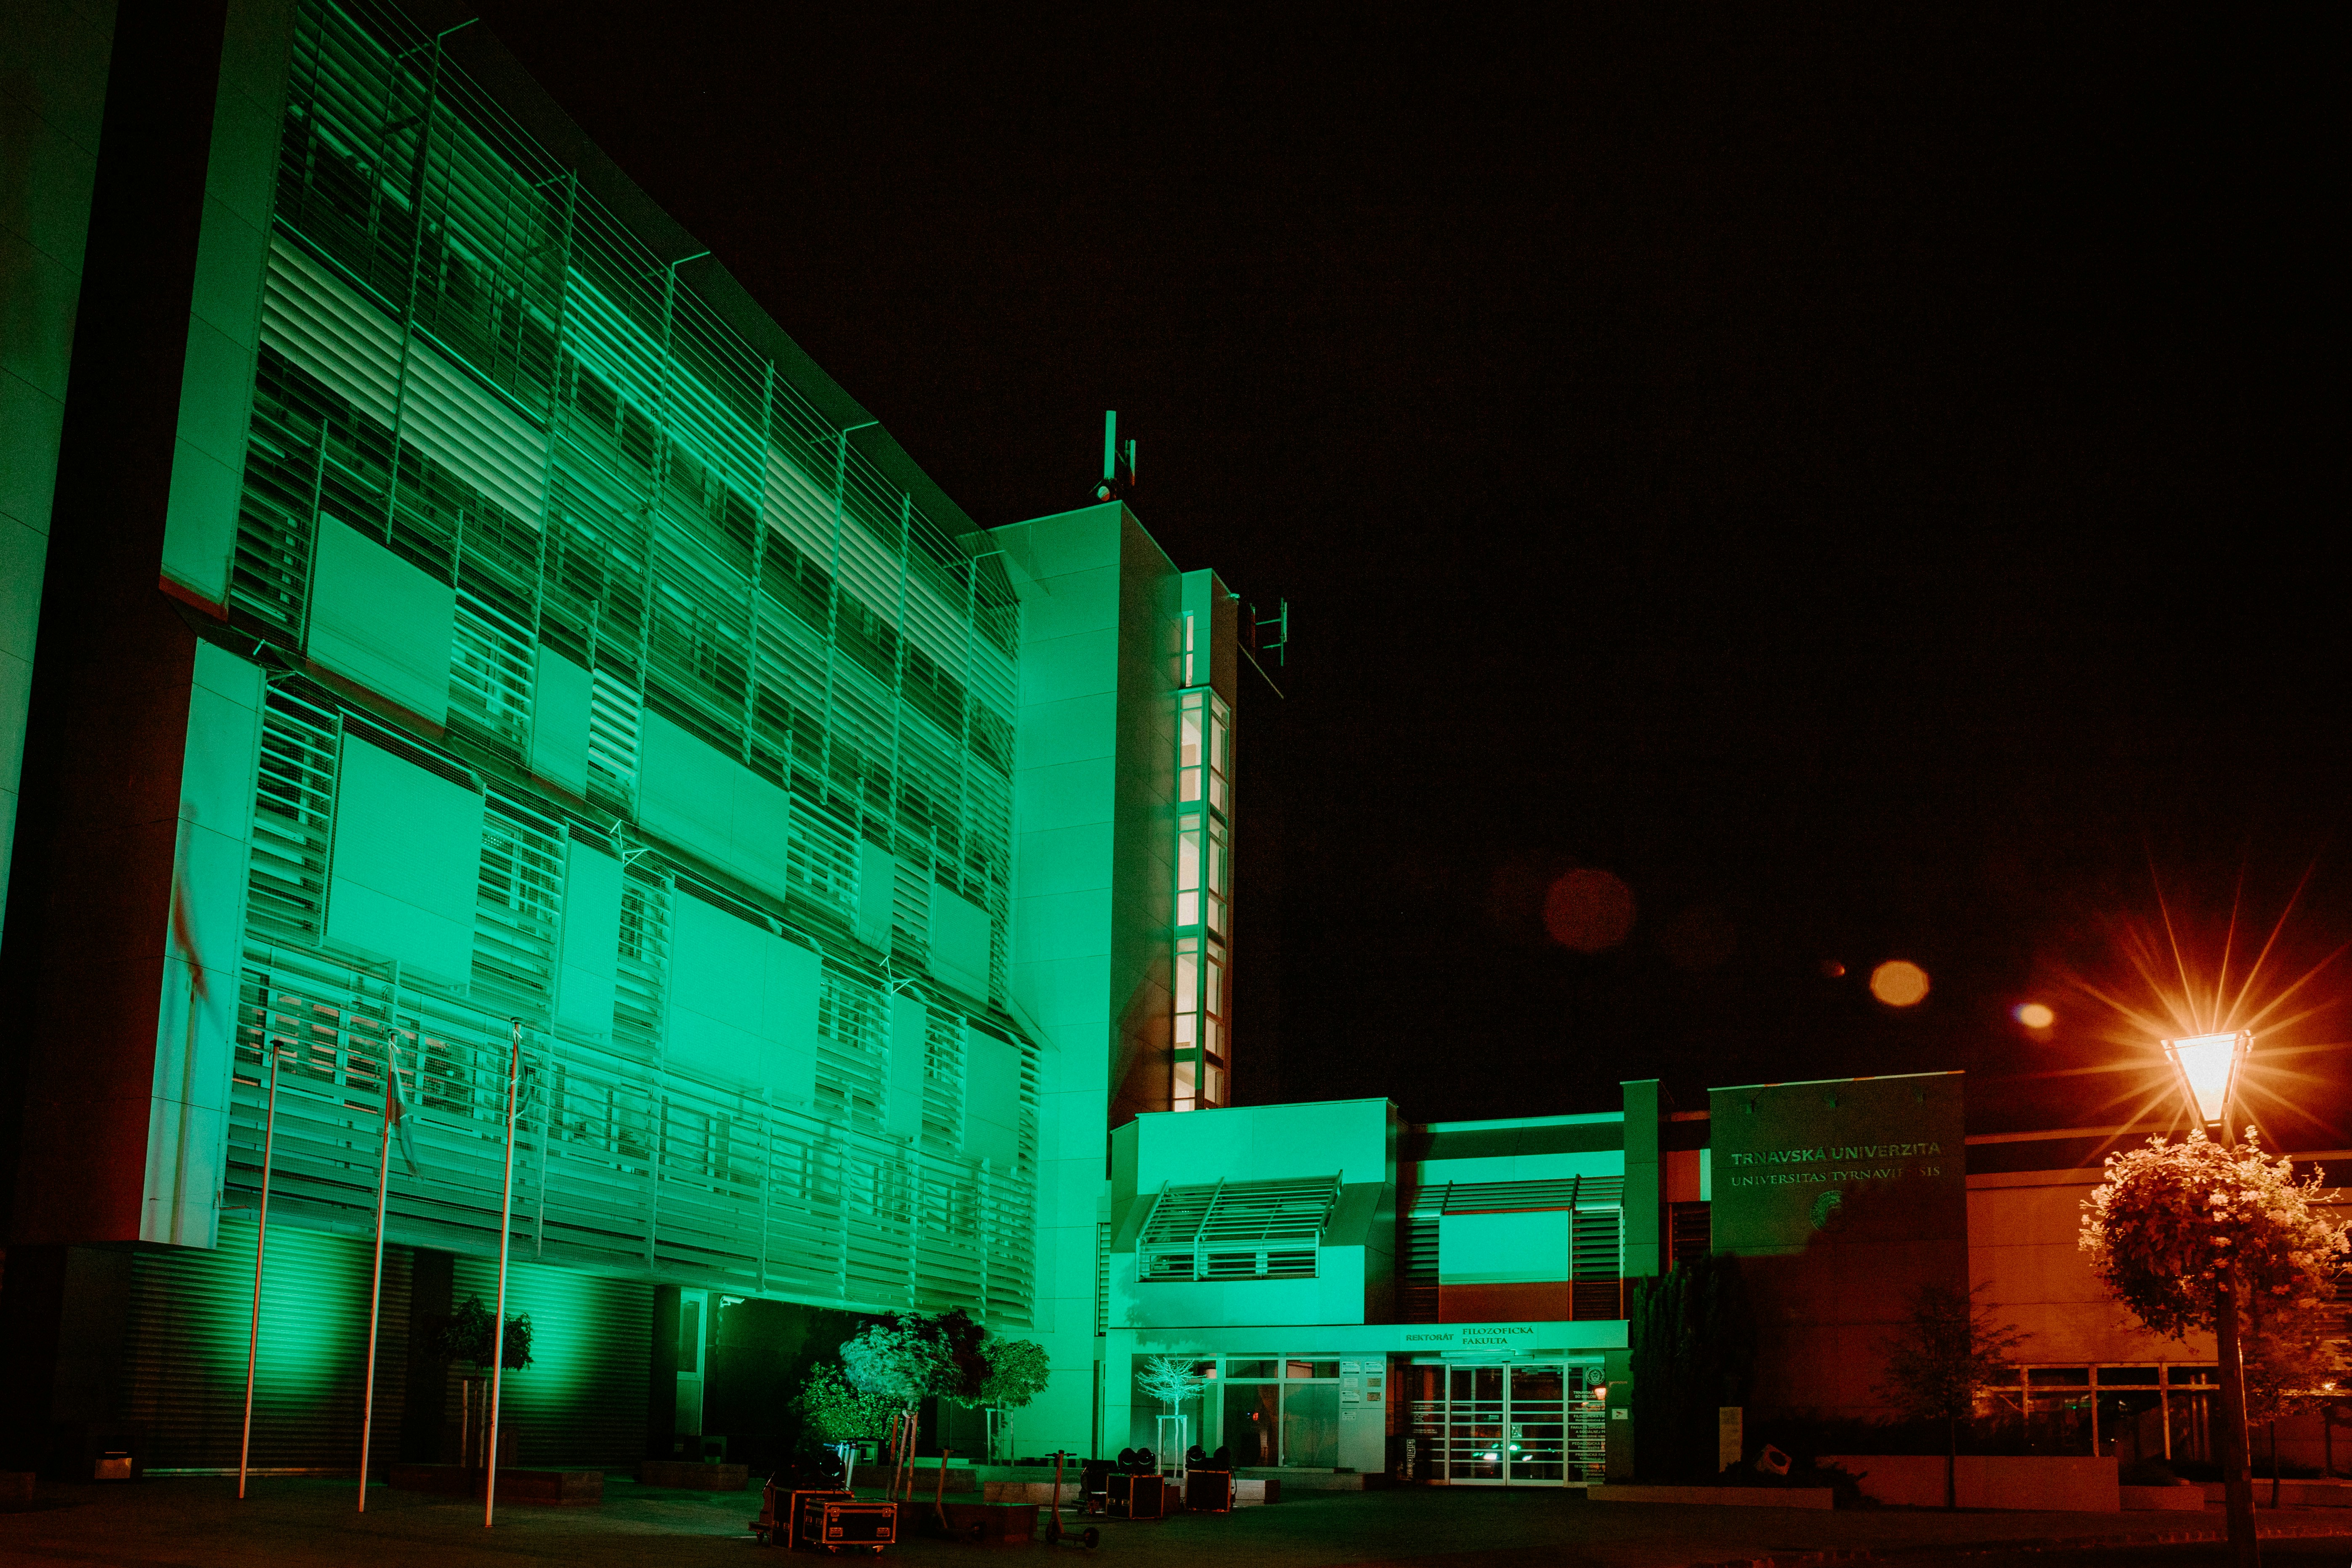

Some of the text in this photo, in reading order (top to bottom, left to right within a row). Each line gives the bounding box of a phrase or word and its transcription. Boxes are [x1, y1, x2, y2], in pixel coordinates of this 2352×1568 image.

[1731, 1142, 1941, 1165] TRNAVSKÁ UNIVERZITA
[1731, 1166, 1940, 1186] UNIVERSITAS TYRNAVISIS
[1463, 1326, 1534, 1335] FILOZOFICKÁ
[1407, 1439, 1416, 1478] bibliobox
